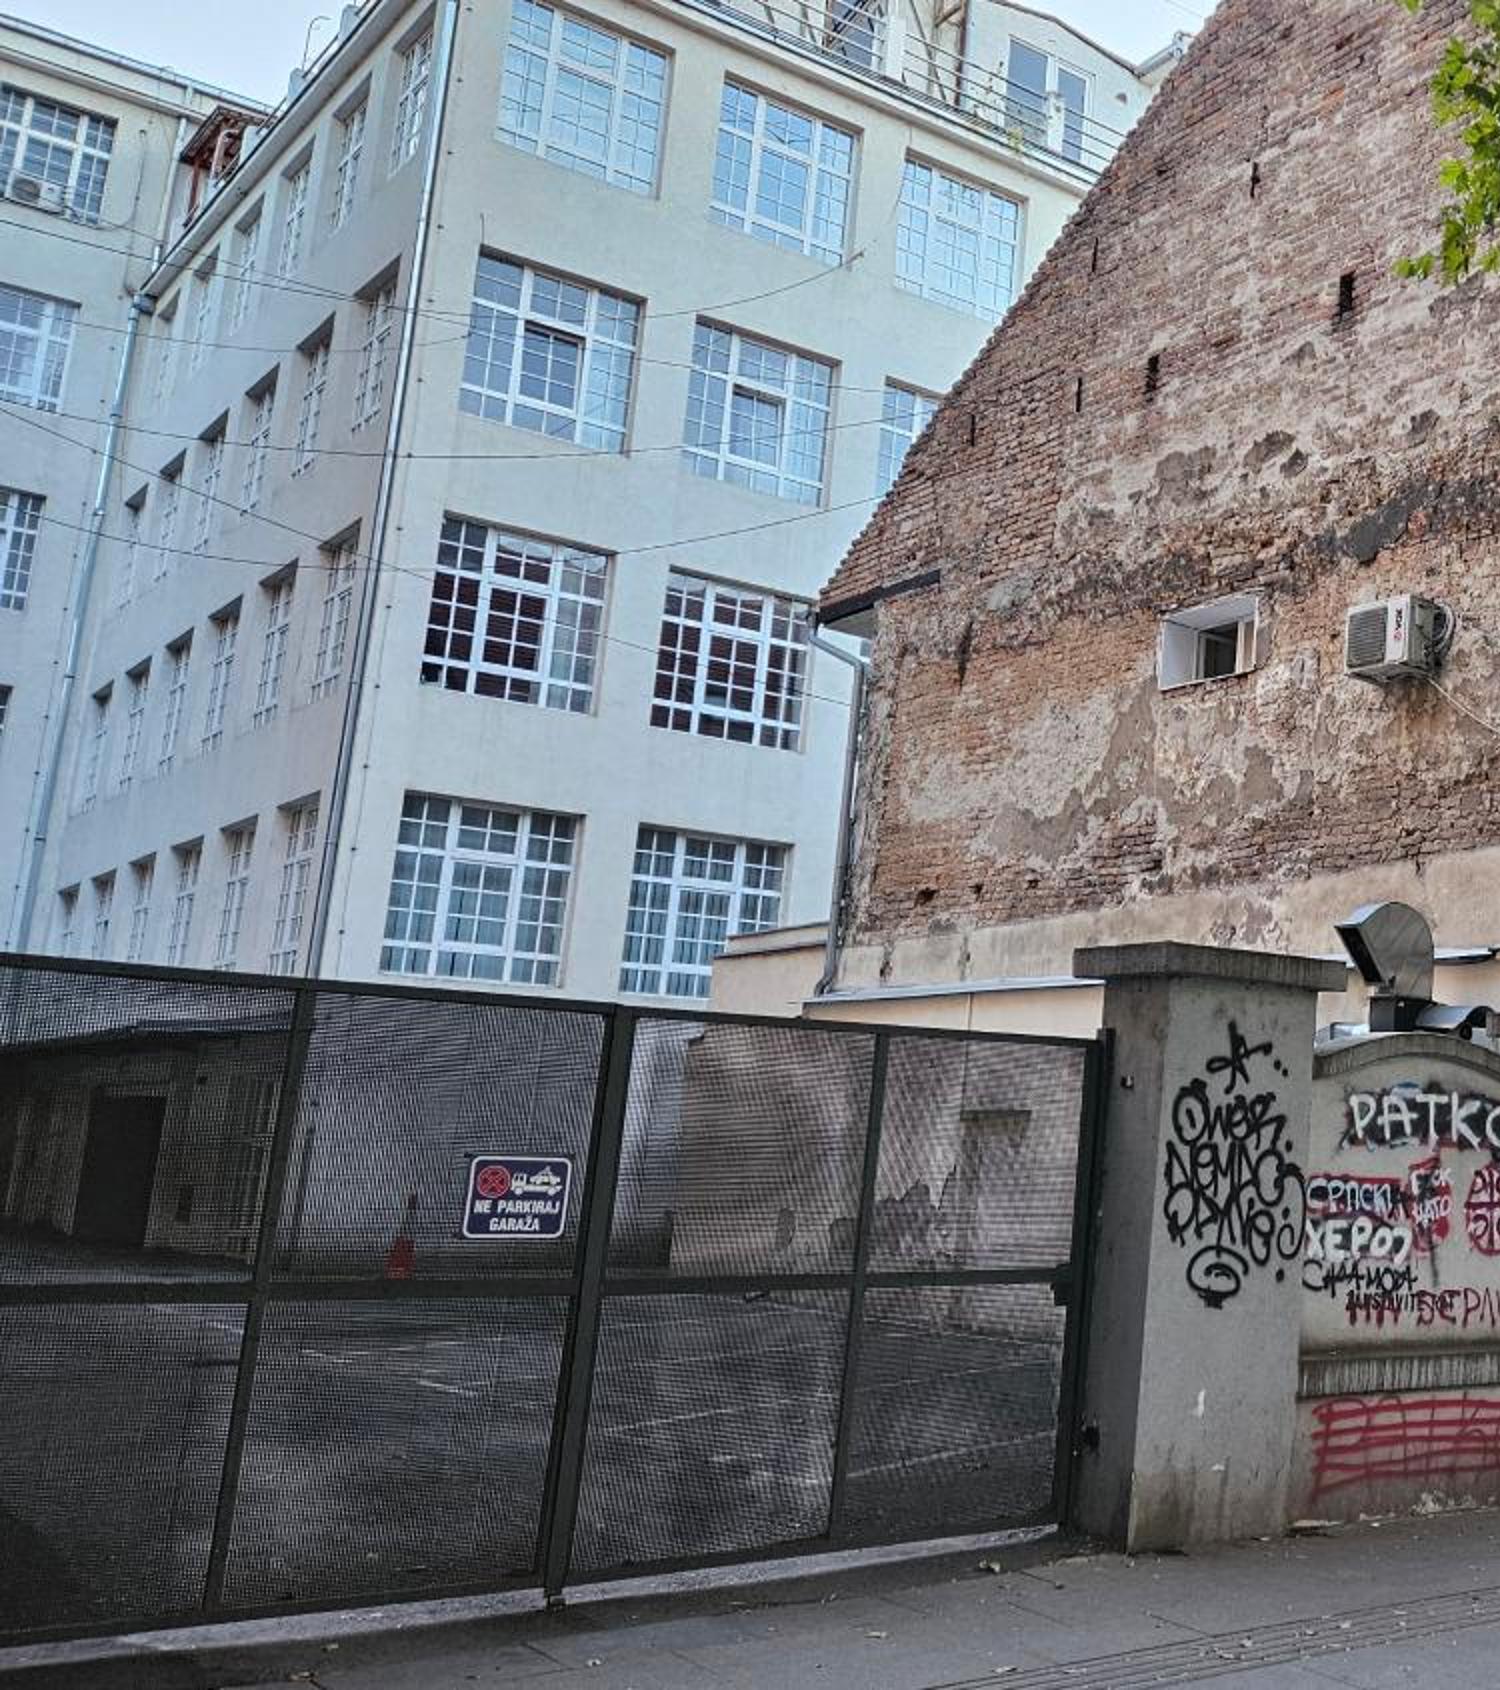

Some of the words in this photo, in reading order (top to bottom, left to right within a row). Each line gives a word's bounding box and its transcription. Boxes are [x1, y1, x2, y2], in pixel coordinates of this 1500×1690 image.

[473, 1199, 492, 1214] NE
[497, 1199, 560, 1214] PARKIRAJ
[489, 1214, 540, 1231] GARAŽA
